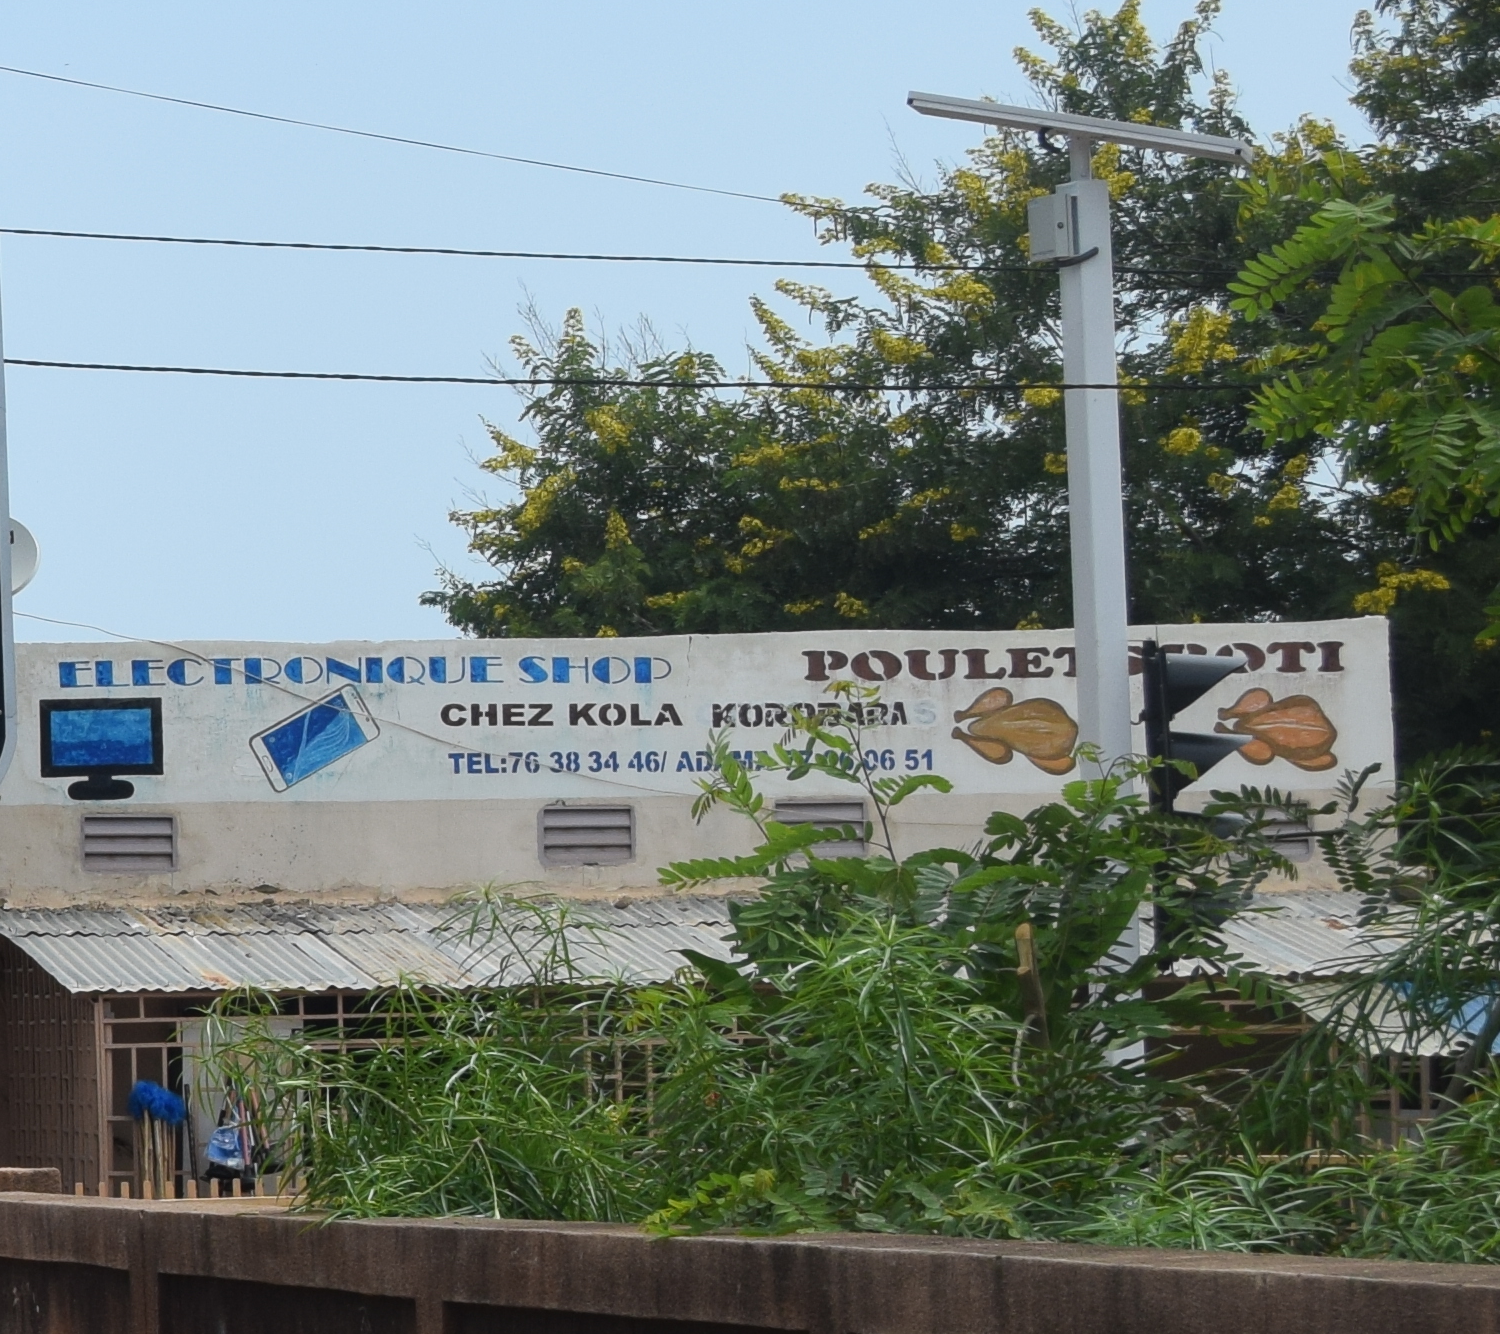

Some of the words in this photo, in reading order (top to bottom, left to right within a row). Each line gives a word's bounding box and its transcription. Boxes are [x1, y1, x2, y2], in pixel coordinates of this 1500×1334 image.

[58, 655, 504, 688] ELECTRONIQUE
[518, 655, 672, 685] SHOP
[440, 702, 554, 727] CHEZ
[569, 702, 684, 727] KOLA
[448, 751, 540, 774] TEL:76
[549, 750, 581, 773] 38
[588, 750, 619, 773] 34
[904, 748, 933, 771] 51
